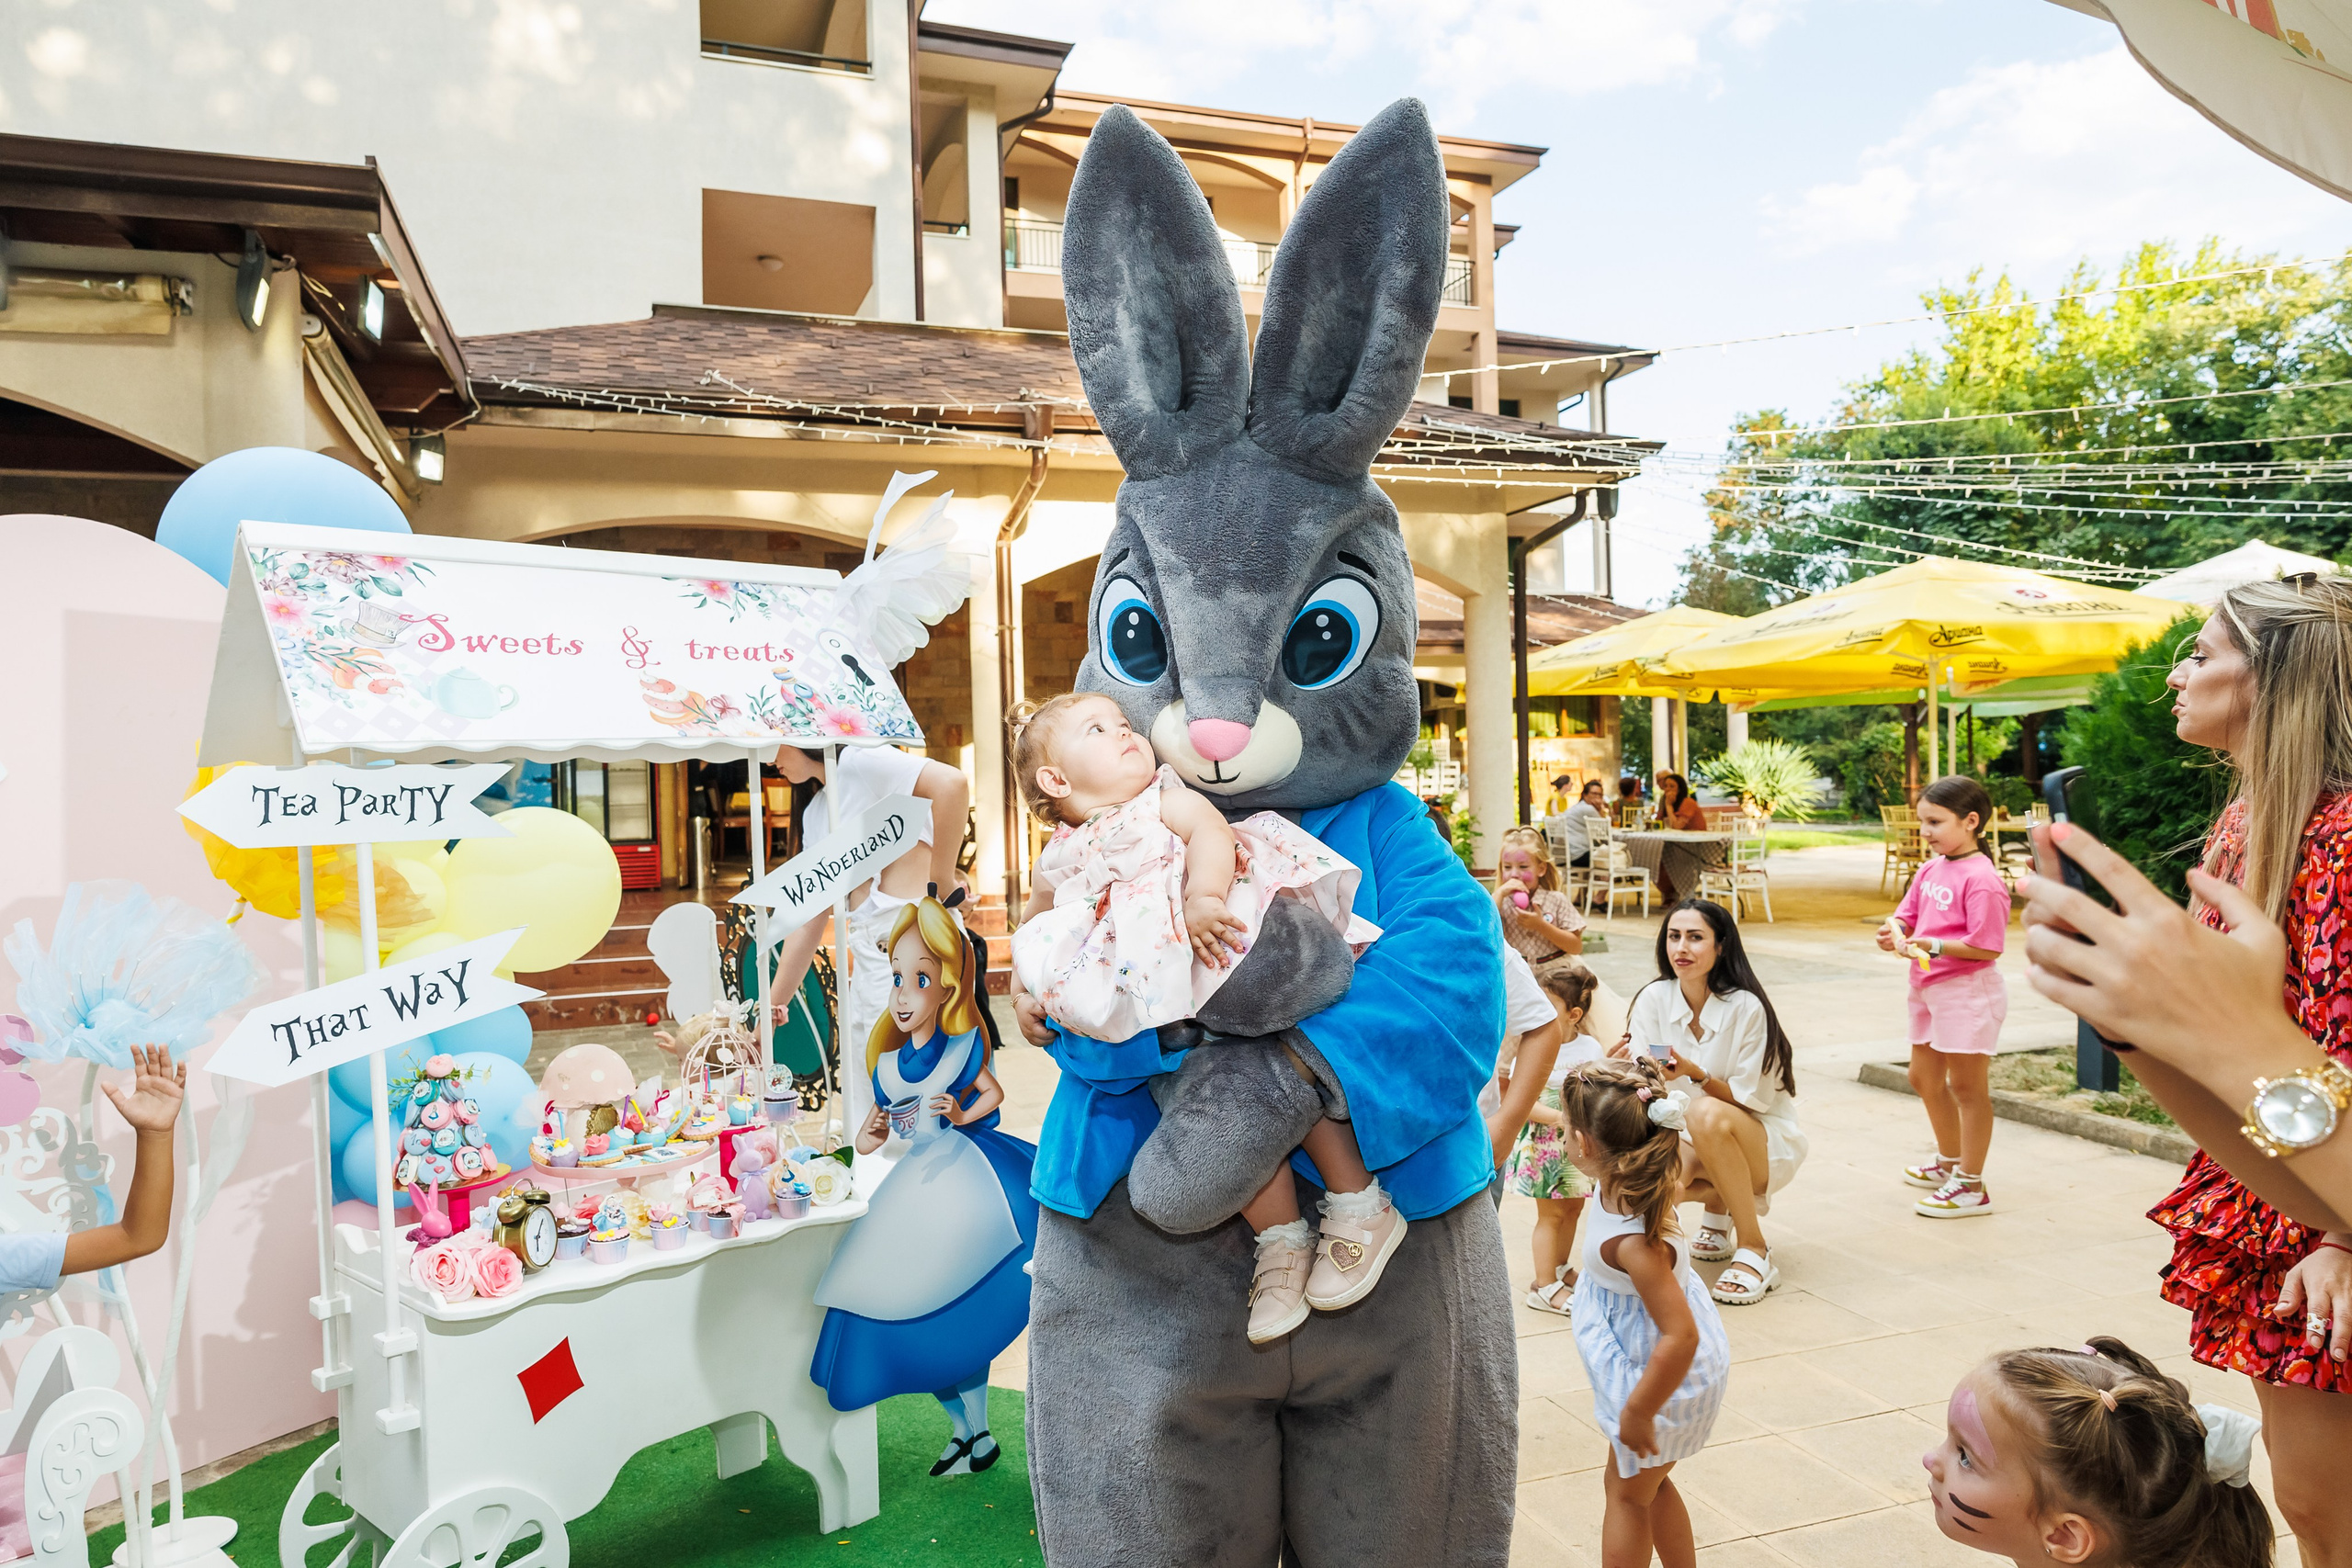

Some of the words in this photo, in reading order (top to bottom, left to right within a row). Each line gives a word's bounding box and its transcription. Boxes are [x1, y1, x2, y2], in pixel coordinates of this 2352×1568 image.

[399, 614, 584, 653] Sweets
[620, 626, 662, 670] &
[684, 638, 795, 662] treats
